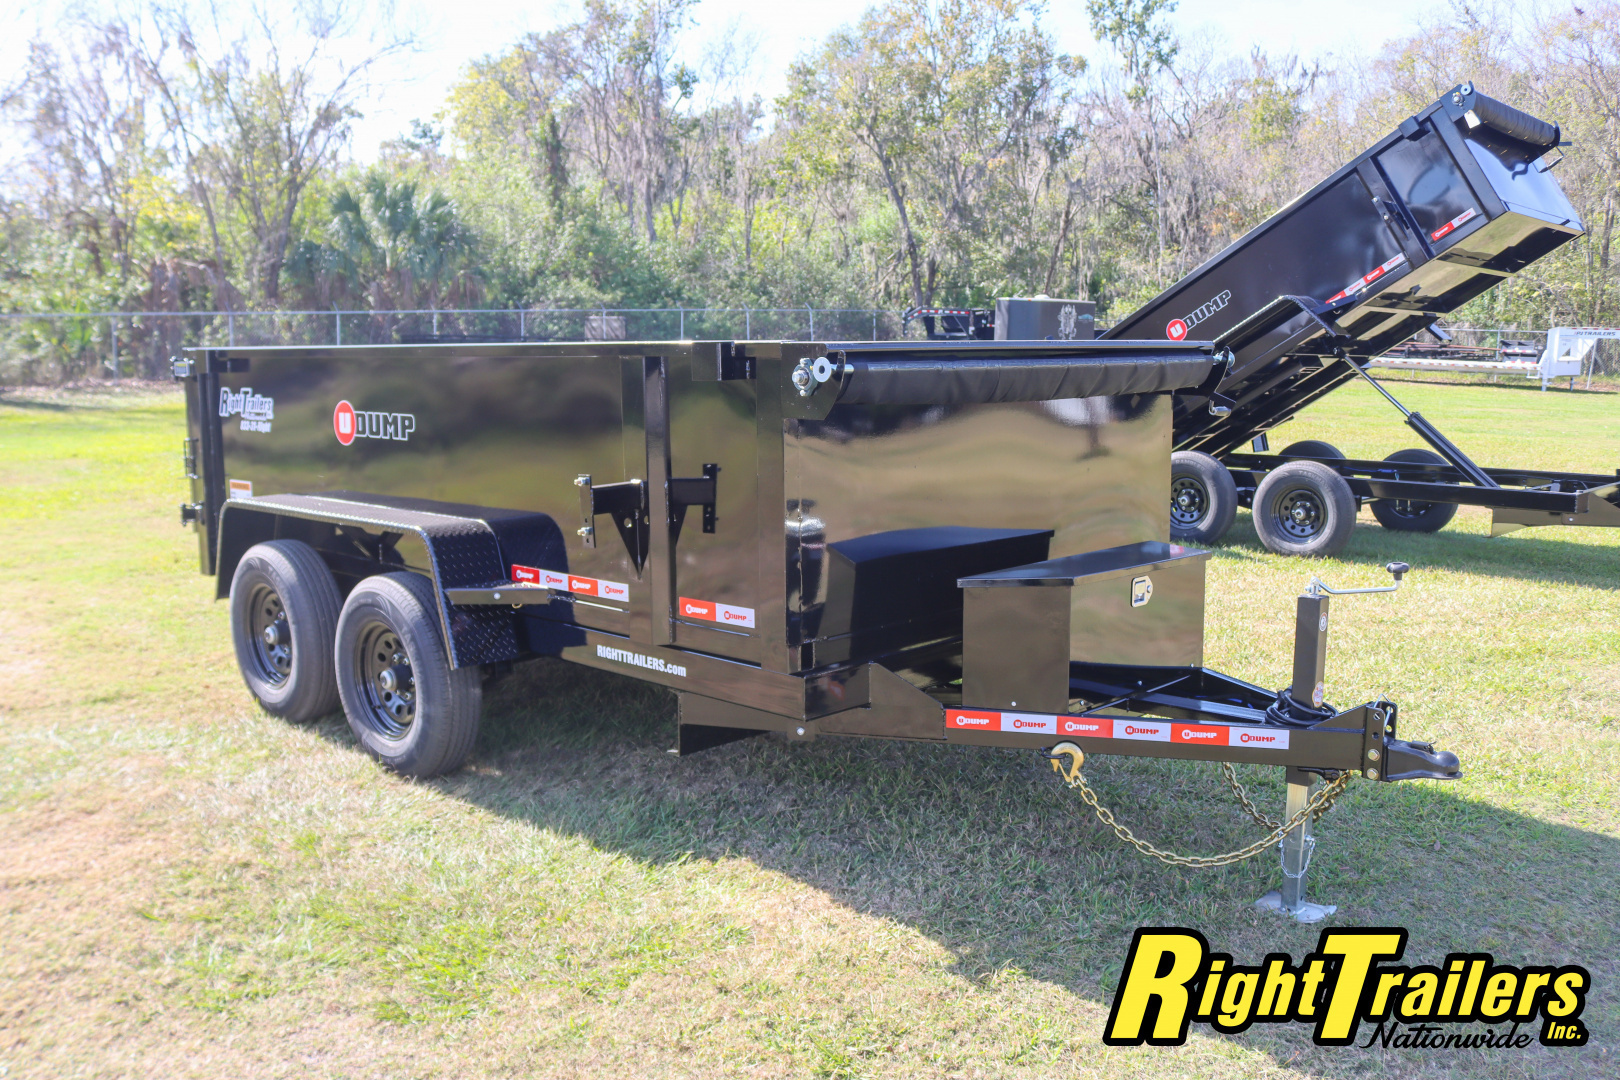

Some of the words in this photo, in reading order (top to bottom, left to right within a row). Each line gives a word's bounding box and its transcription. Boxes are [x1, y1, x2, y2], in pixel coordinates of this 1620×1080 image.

[334, 403, 415, 444] UDUMP
[596, 644, 687, 678] RIGHTTRAILERS.com
[956, 715, 990, 726] UDUMP
[1013, 719, 1047, 729] UDUMP
[1065, 720, 1099, 732] UDUMP
[1124, 725, 1160, 736] UDUMP
[1181, 729, 1218, 740] UDUMP
[1240, 732, 1277, 744] UDUMP
